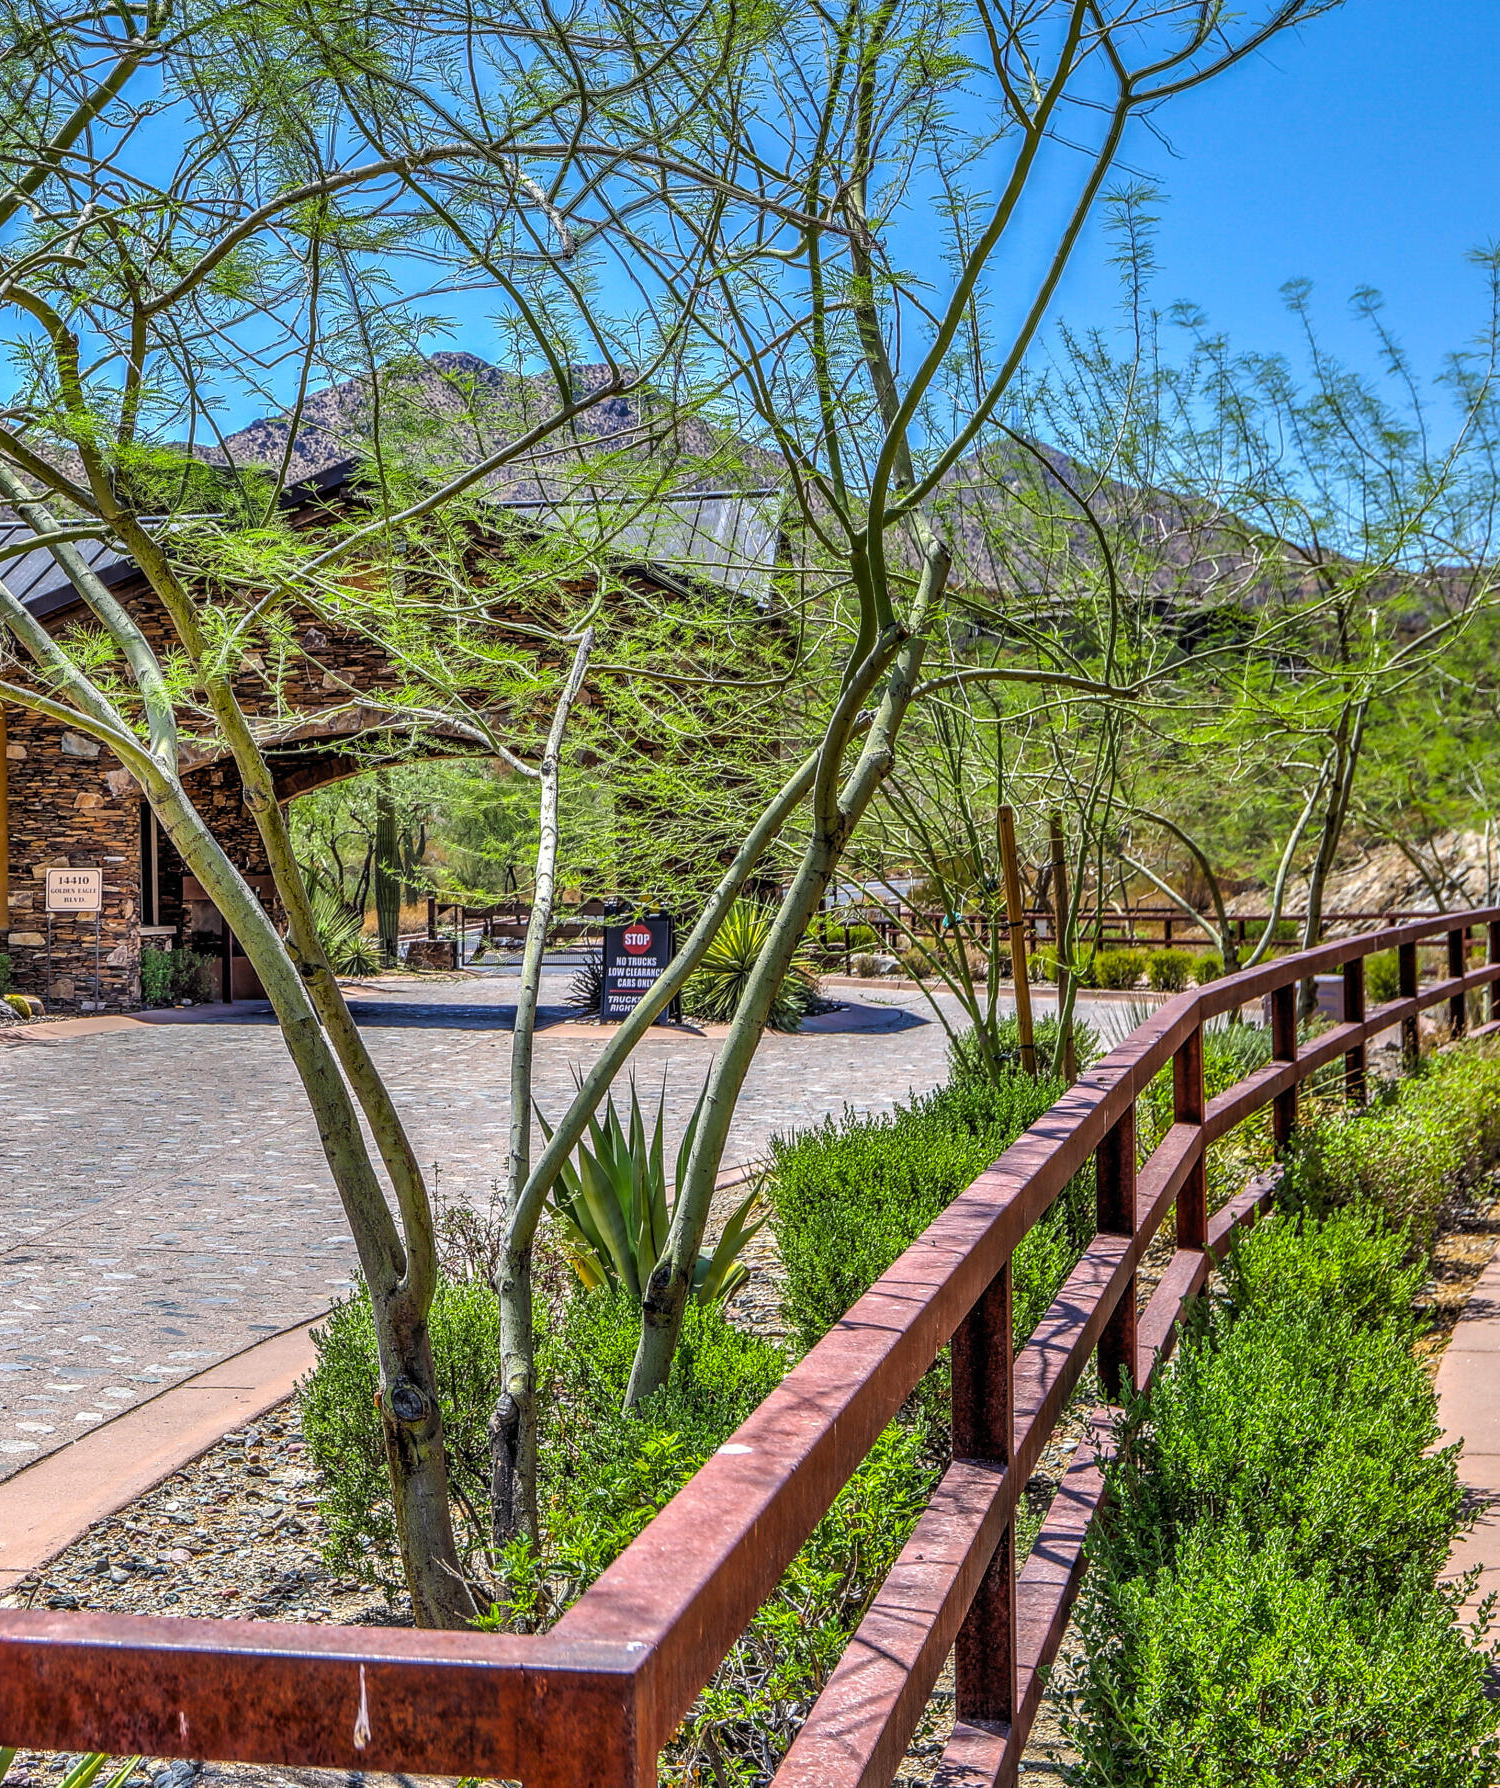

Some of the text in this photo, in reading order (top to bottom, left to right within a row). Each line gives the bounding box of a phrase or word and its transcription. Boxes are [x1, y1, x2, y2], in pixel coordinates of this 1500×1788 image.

[59, 876, 90, 885] 14410
[624, 933, 650, 946] STOP
[616, 956, 657, 966] NO TRUCKS
[608, 967, 625, 977] LOW
[617, 978, 654, 988] CARS ONLY
[610, 1004, 635, 1012] RIGHT
